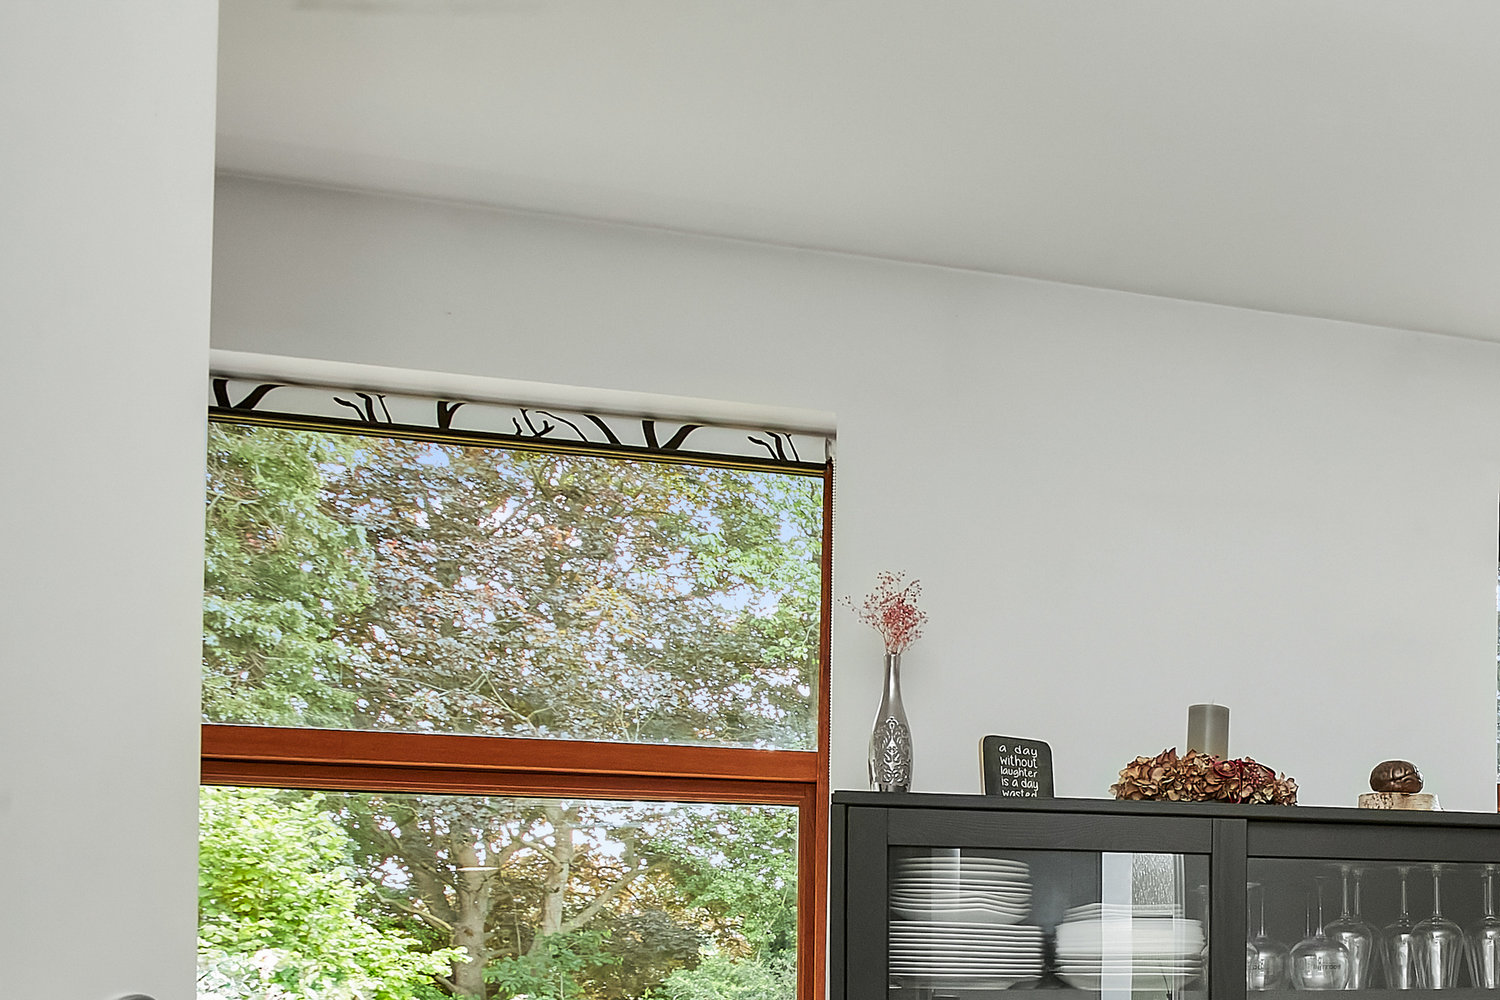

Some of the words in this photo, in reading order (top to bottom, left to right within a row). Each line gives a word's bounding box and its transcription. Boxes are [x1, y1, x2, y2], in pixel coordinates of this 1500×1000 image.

[999, 744, 1007, 753] a
[1014, 745, 1038, 758] day
[1000, 755, 1038, 769] without
[1001, 766, 1038, 778] laughter
[1012, 779, 1019, 787] a
[1021, 778, 1039, 791] day
